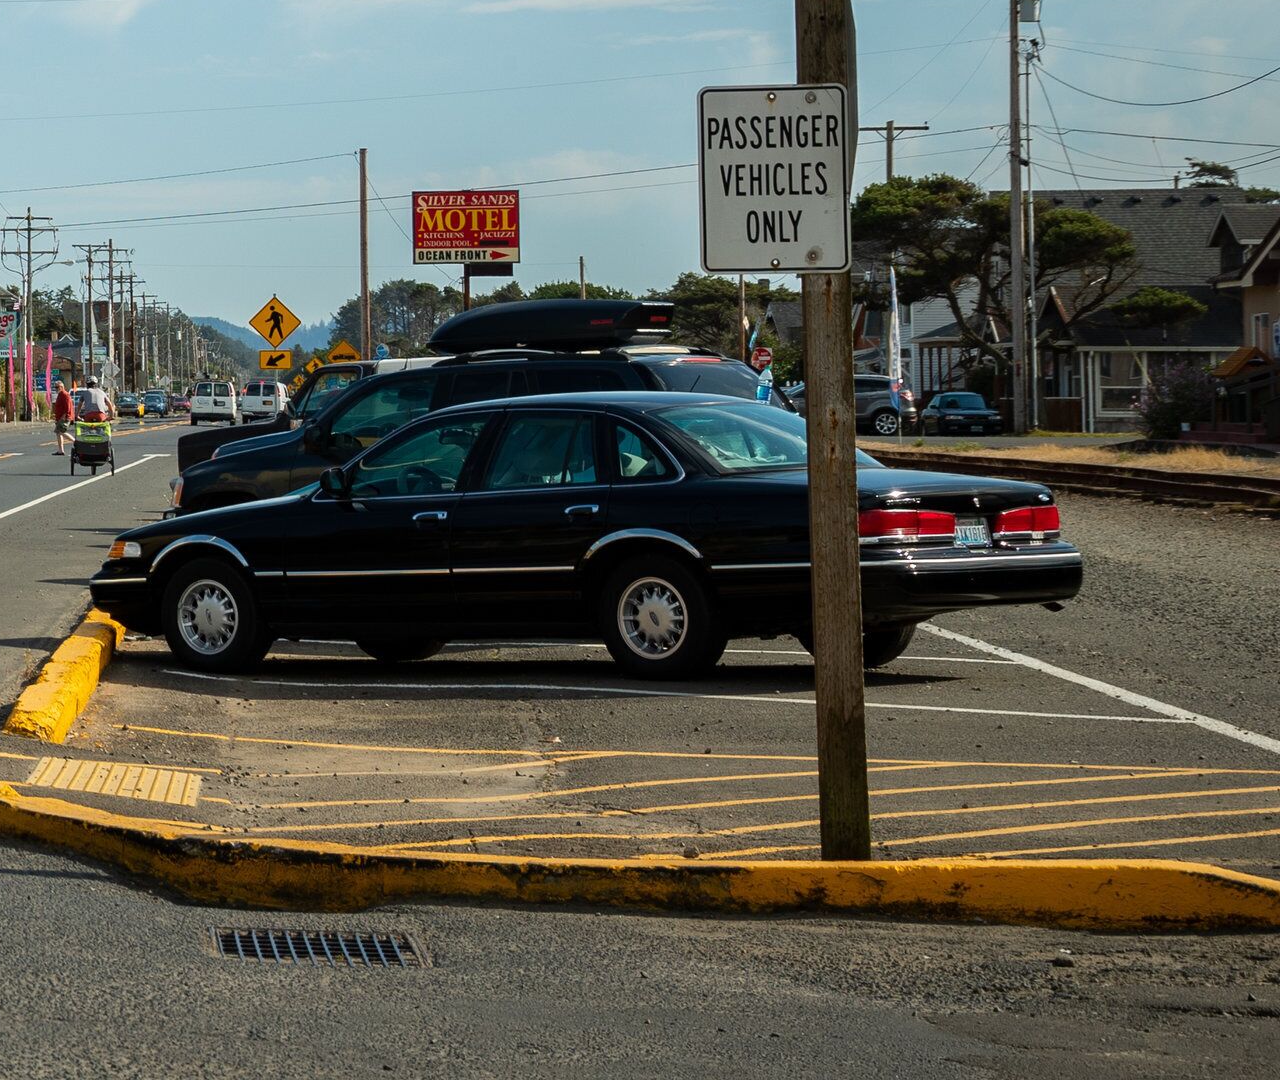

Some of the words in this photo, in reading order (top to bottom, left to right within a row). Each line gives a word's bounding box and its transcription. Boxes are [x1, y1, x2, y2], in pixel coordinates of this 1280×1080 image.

[707, 114, 839, 150] PASSENGER
[720, 161, 828, 197] VEHICLES
[417, 195, 466, 213] SILVER
[471, 194, 516, 205] SANDS
[418, 208, 517, 232] MOTEL
[746, 209, 803, 244] ONLY
[480, 231, 515, 240] JACUZZI
[418, 250, 452, 260] OCEAN
[454, 250, 487, 260] FRONT
